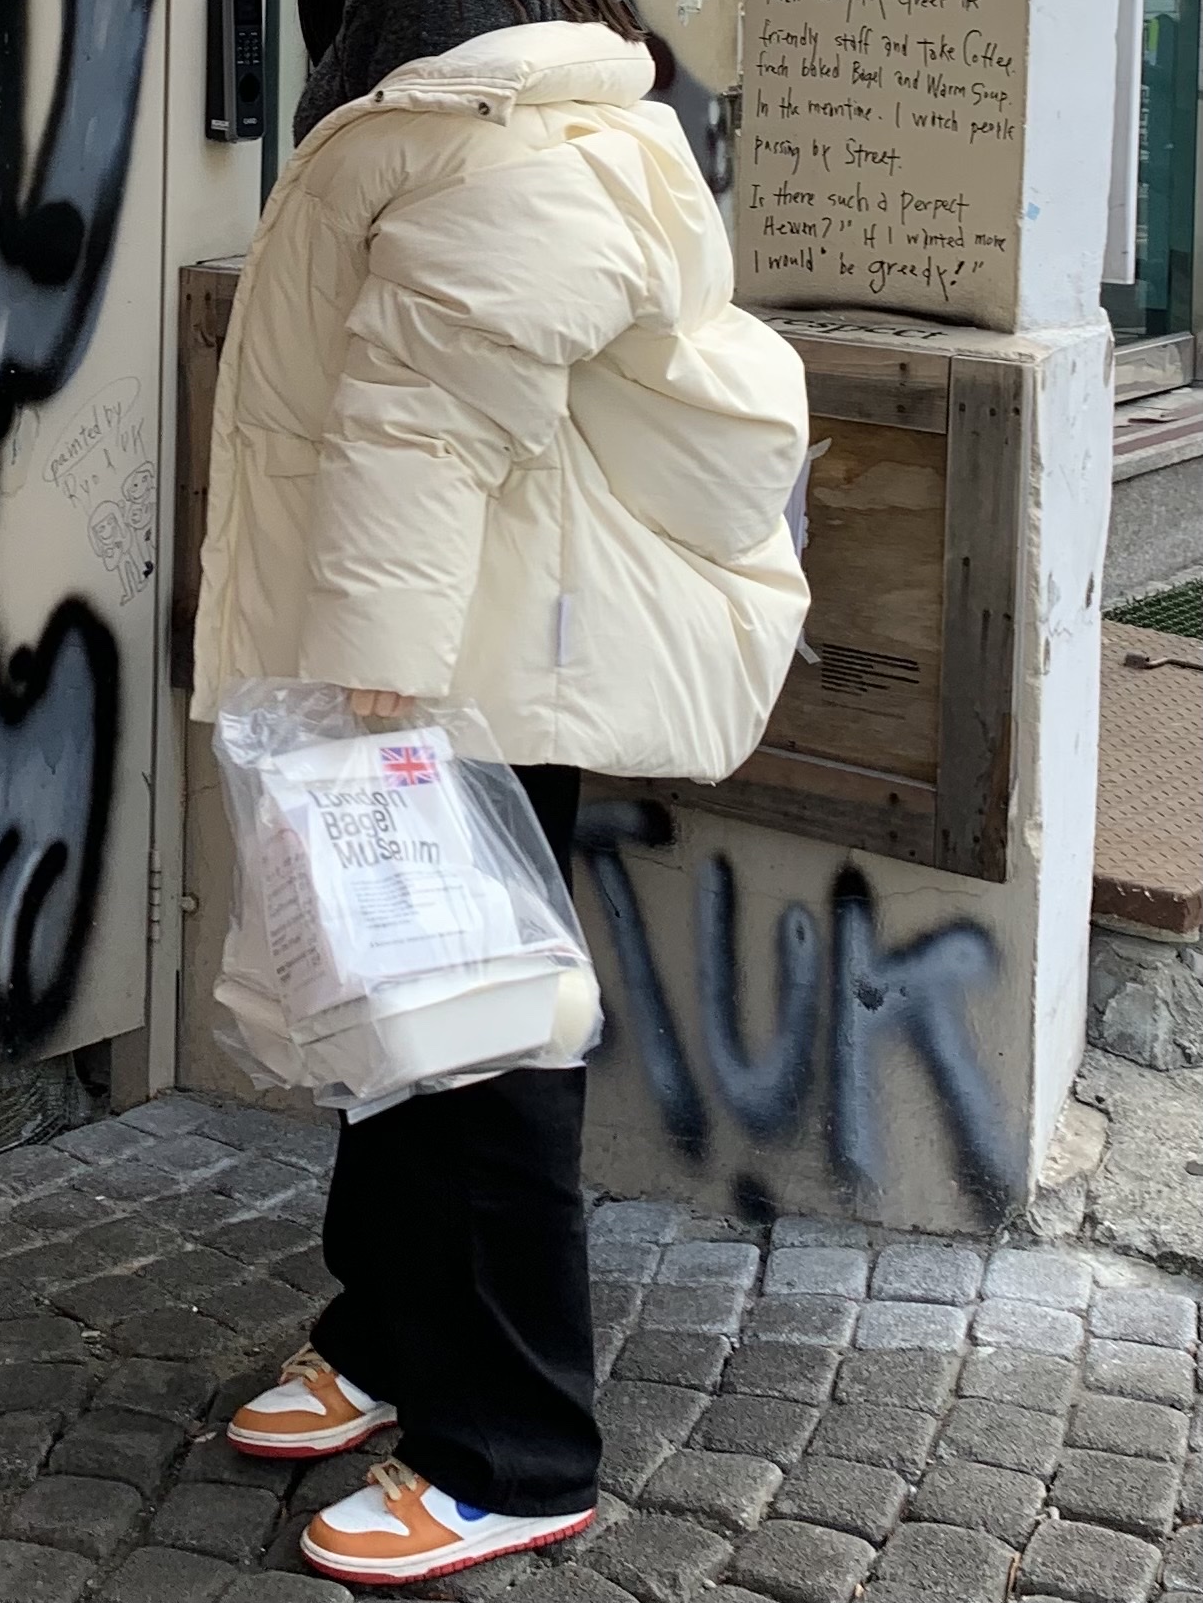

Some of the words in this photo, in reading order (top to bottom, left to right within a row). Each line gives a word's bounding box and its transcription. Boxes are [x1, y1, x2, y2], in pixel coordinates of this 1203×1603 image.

[758, 18, 819, 64] friendly
[834, 25, 873, 55] staff
[881, 34, 908, 57] and
[801, 53, 840, 79] baked
[852, 60, 883, 89] Bagel
[894, 70, 920, 90] and
[927, 73, 966, 99] Warm
[756, 87, 769, 118] In
[778, 86, 800, 120] the
[895, 101, 901, 129] I
[812, 138, 832, 173] by
[749, 184, 765, 209] Is
[773, 180, 816, 207] there
[828, 181, 870, 212] such
[877, 192, 888, 212] a
[863, 223, 878, 249] If
[974, 233, 1007, 253] more
[840, 252, 854, 276] be
[762, 316, 950, 340] respect
[321, 807, 397, 841] Bagel
[332, 837, 441, 869] Museum
